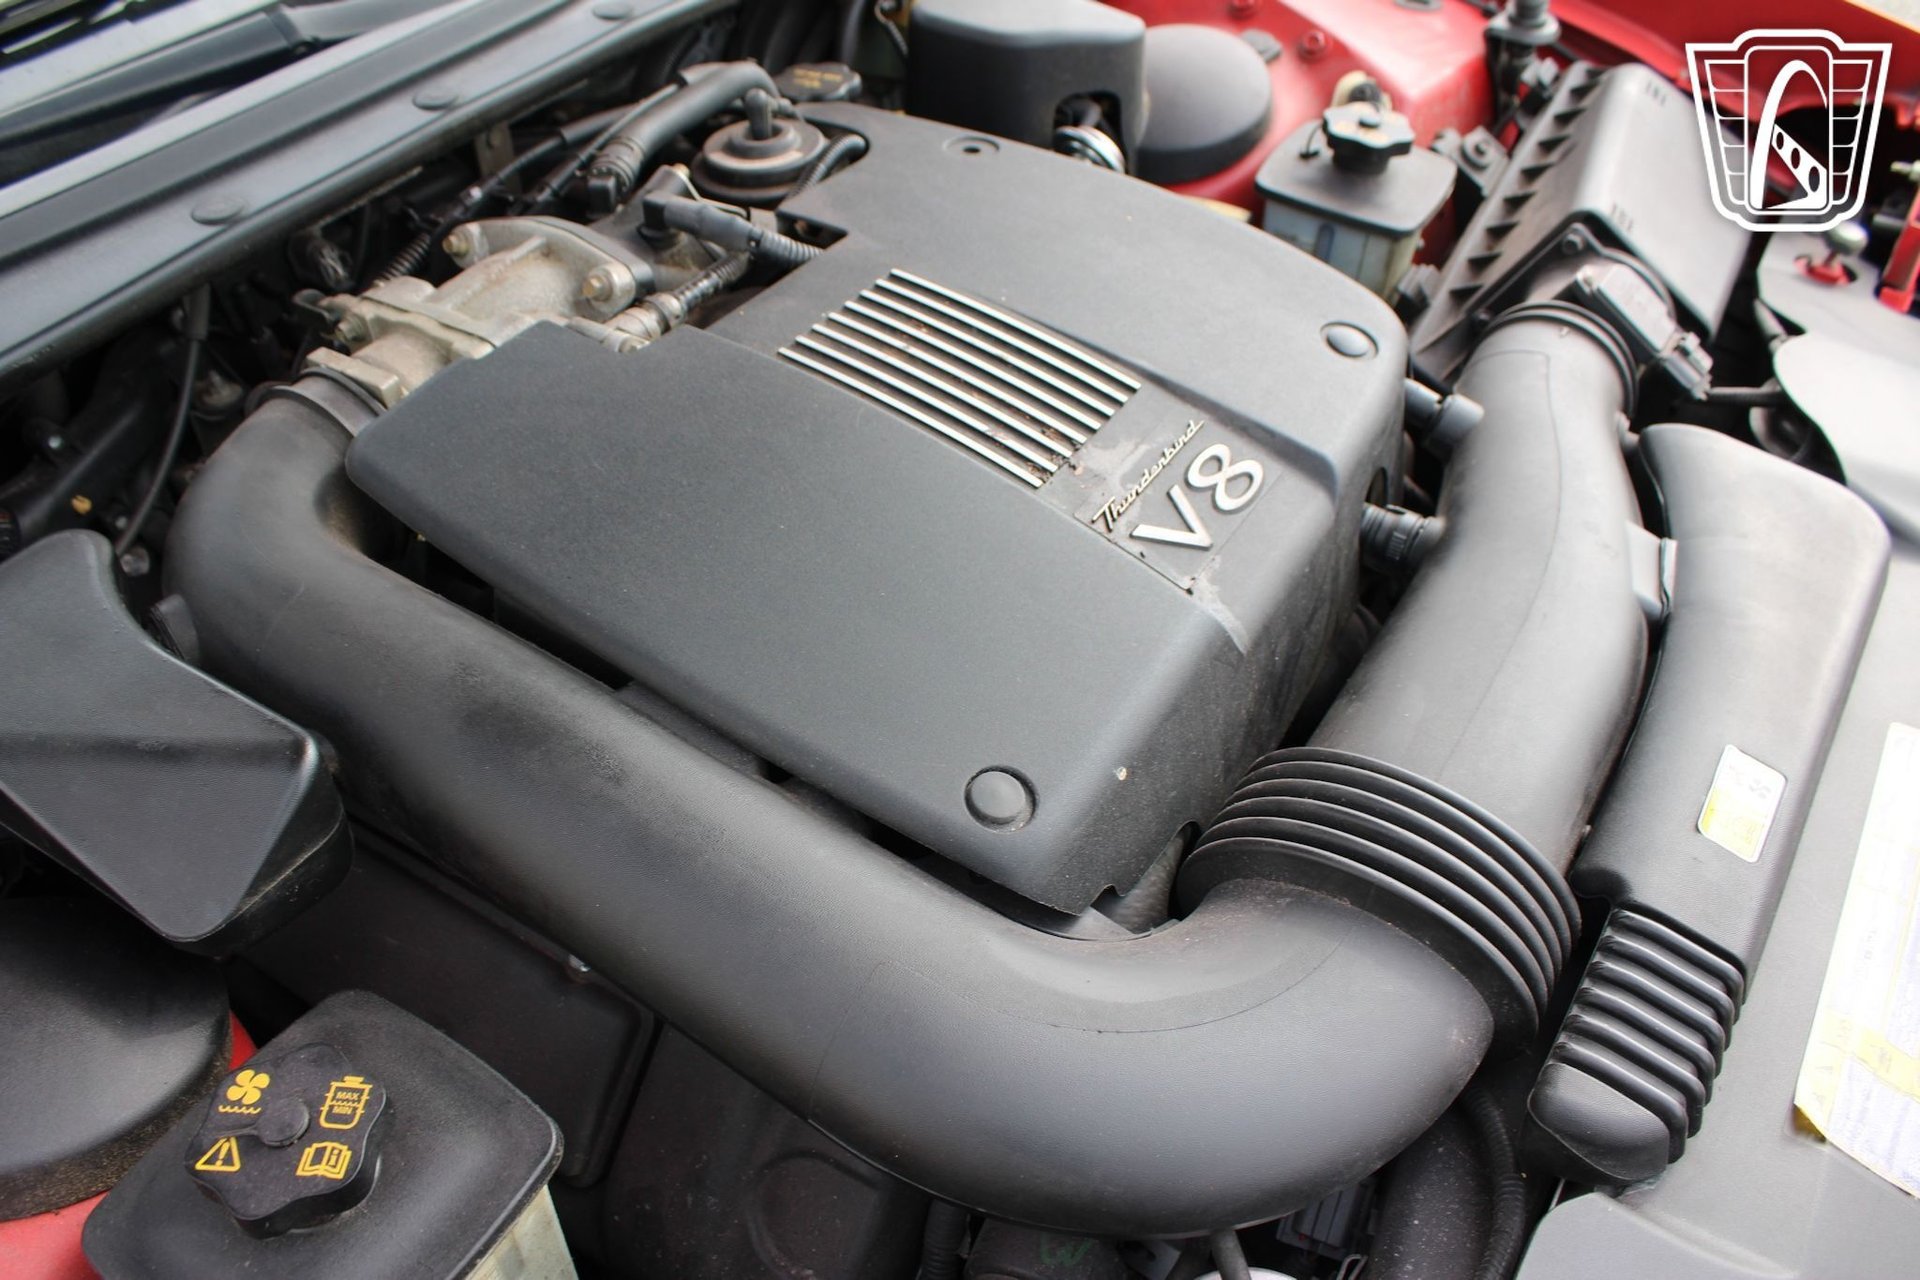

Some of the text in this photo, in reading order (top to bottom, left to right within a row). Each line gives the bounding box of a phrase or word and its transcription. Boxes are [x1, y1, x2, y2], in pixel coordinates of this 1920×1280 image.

[1091, 419, 1206, 532] Thunderbird
[1130, 443, 1264, 551] V8
[332, 1106, 353, 1114] MIN
[336, 1091, 360, 1100] MAX
